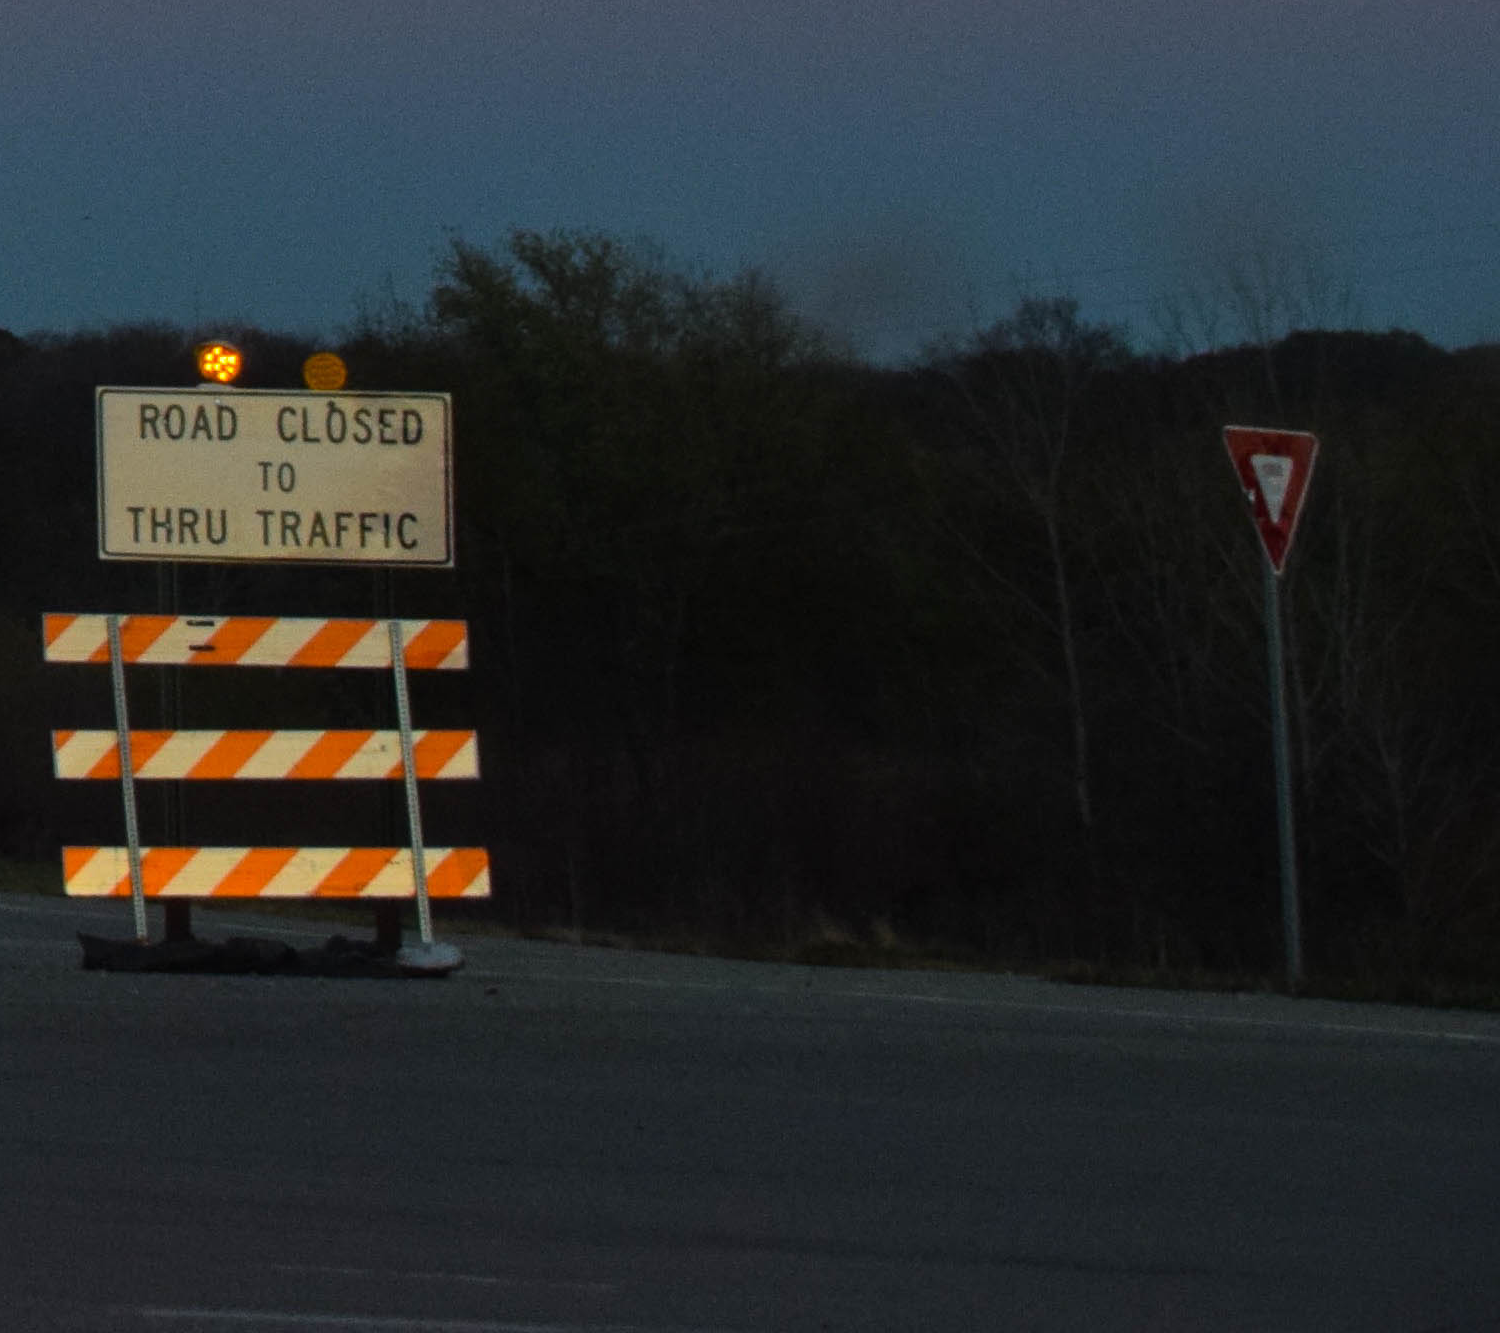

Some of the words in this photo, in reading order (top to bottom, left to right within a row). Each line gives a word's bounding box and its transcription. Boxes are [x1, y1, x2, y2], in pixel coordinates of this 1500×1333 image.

[139, 403, 238, 441] ROAD
[277, 406, 424, 445] CLOSED
[257, 461, 296, 493] TO
[126, 507, 228, 545] THRU
[256, 510, 419, 550] TRAFFIC
